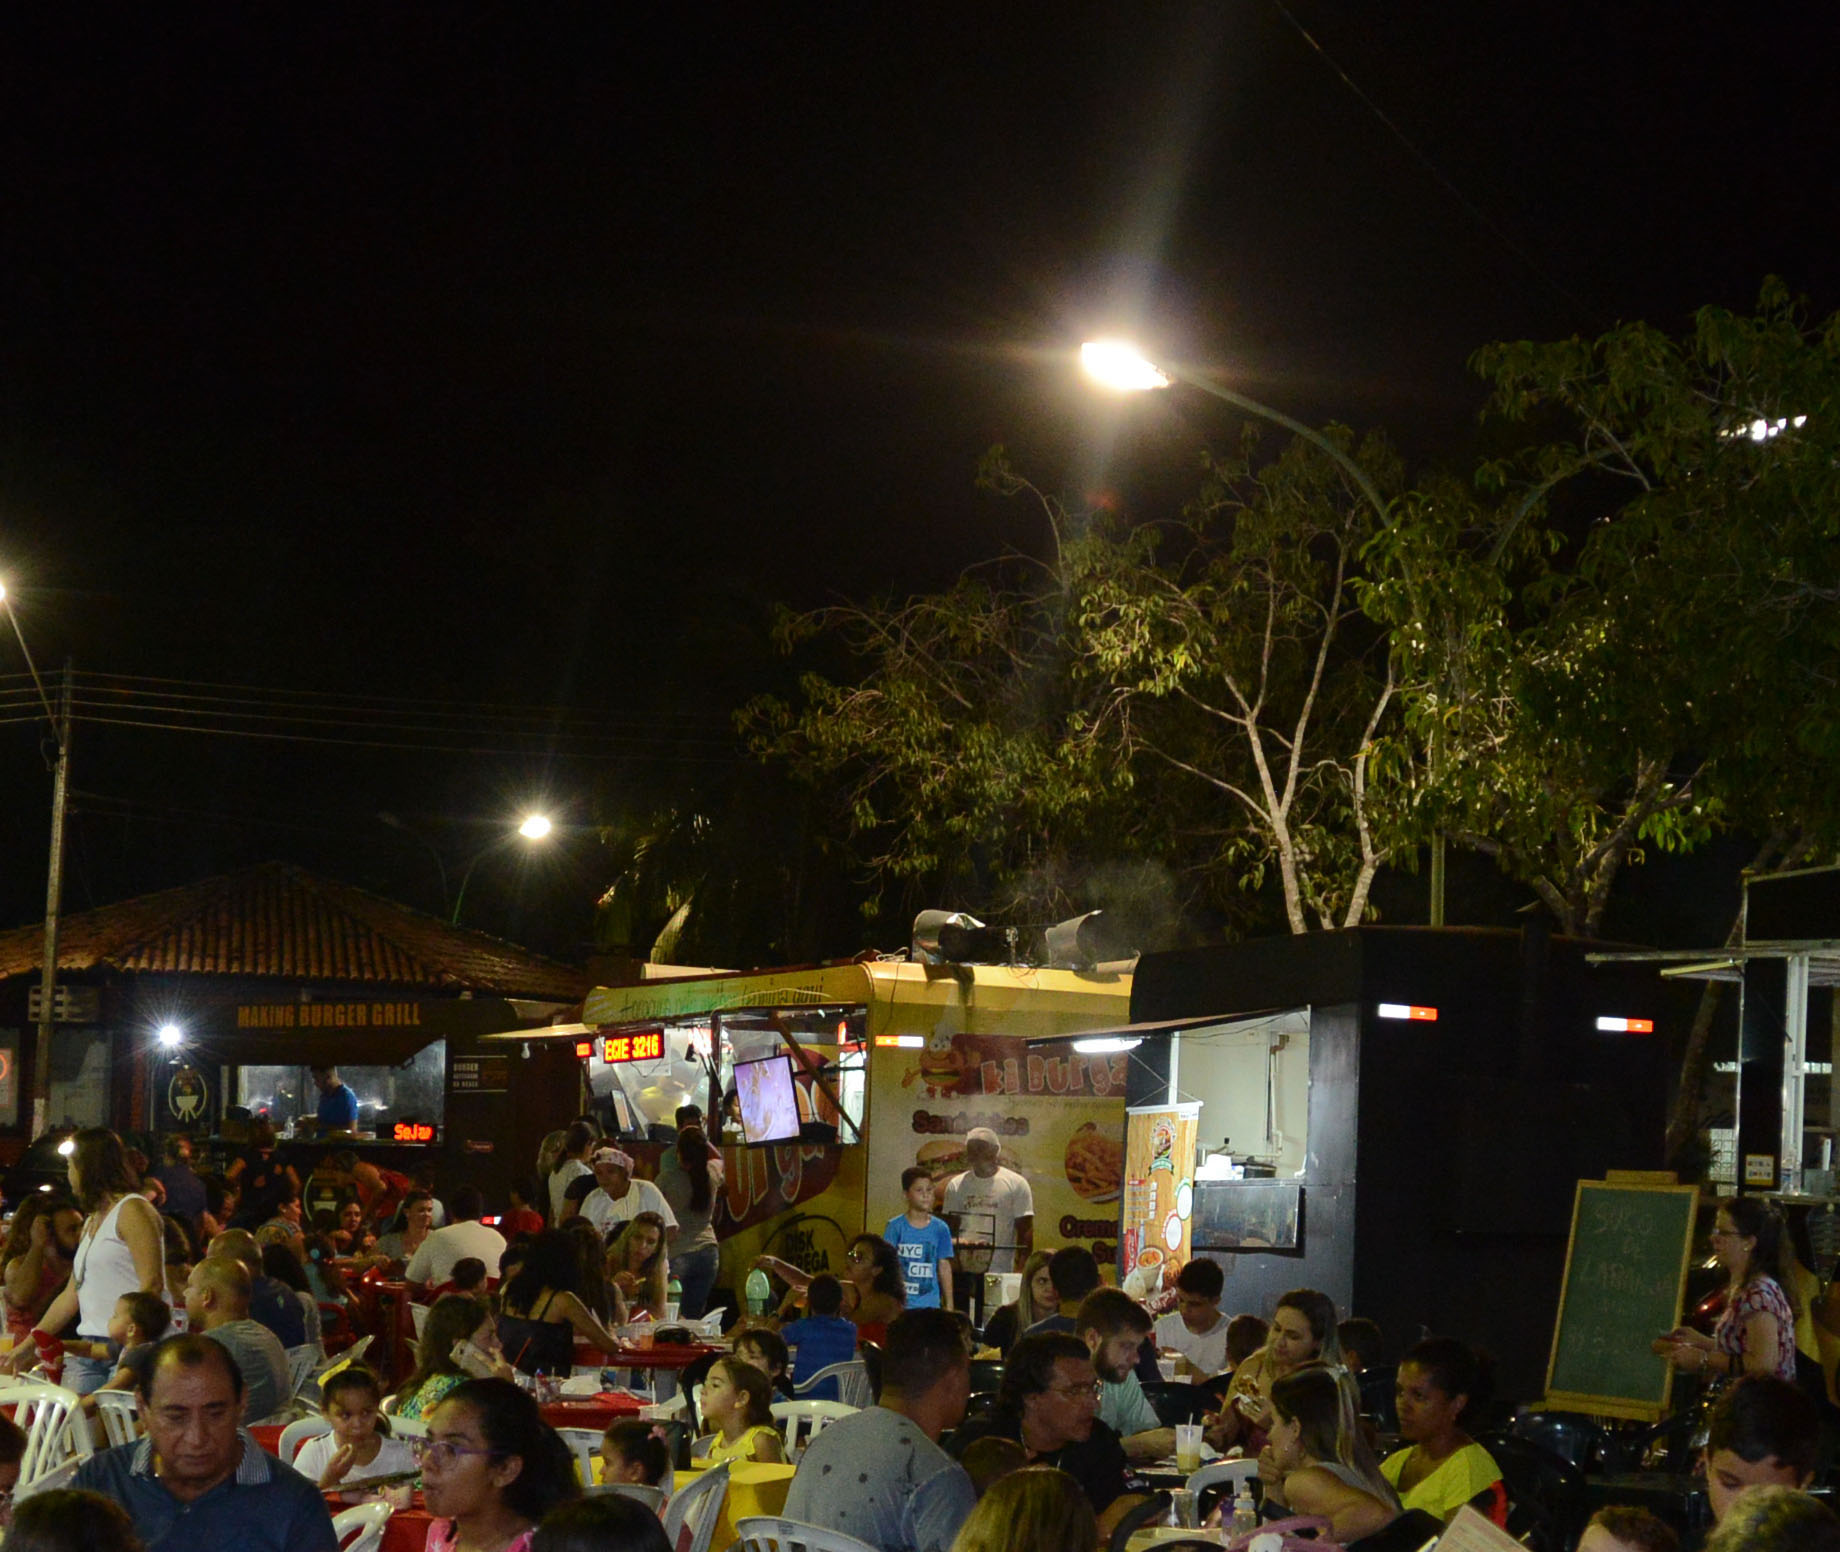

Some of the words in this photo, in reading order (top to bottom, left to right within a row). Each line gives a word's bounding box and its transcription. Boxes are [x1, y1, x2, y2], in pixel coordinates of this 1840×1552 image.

[237, 1004, 295, 1028] MAKING
[299, 1003, 368, 1027] BURGER
[371, 1002, 421, 1026] GRILL
[631, 1033, 661, 1060] 3216
[910, 1264, 933, 1276] CIT
